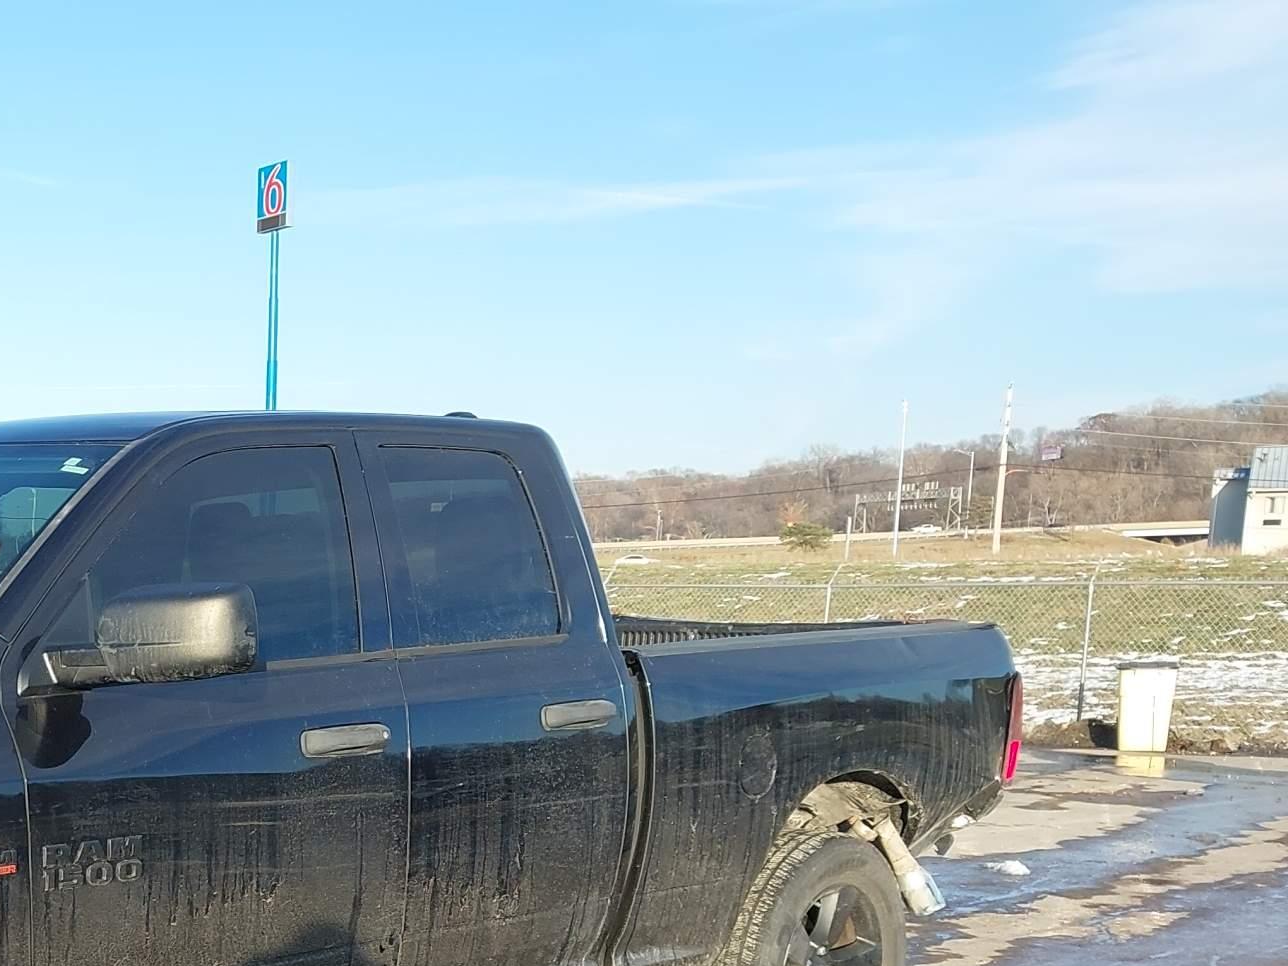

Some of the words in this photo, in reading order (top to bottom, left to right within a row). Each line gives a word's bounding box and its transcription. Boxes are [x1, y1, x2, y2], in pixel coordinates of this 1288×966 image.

[263, 163, 285, 217] 6
[42, 835, 143, 867] RAM
[42, 858, 143, 893] 1500
